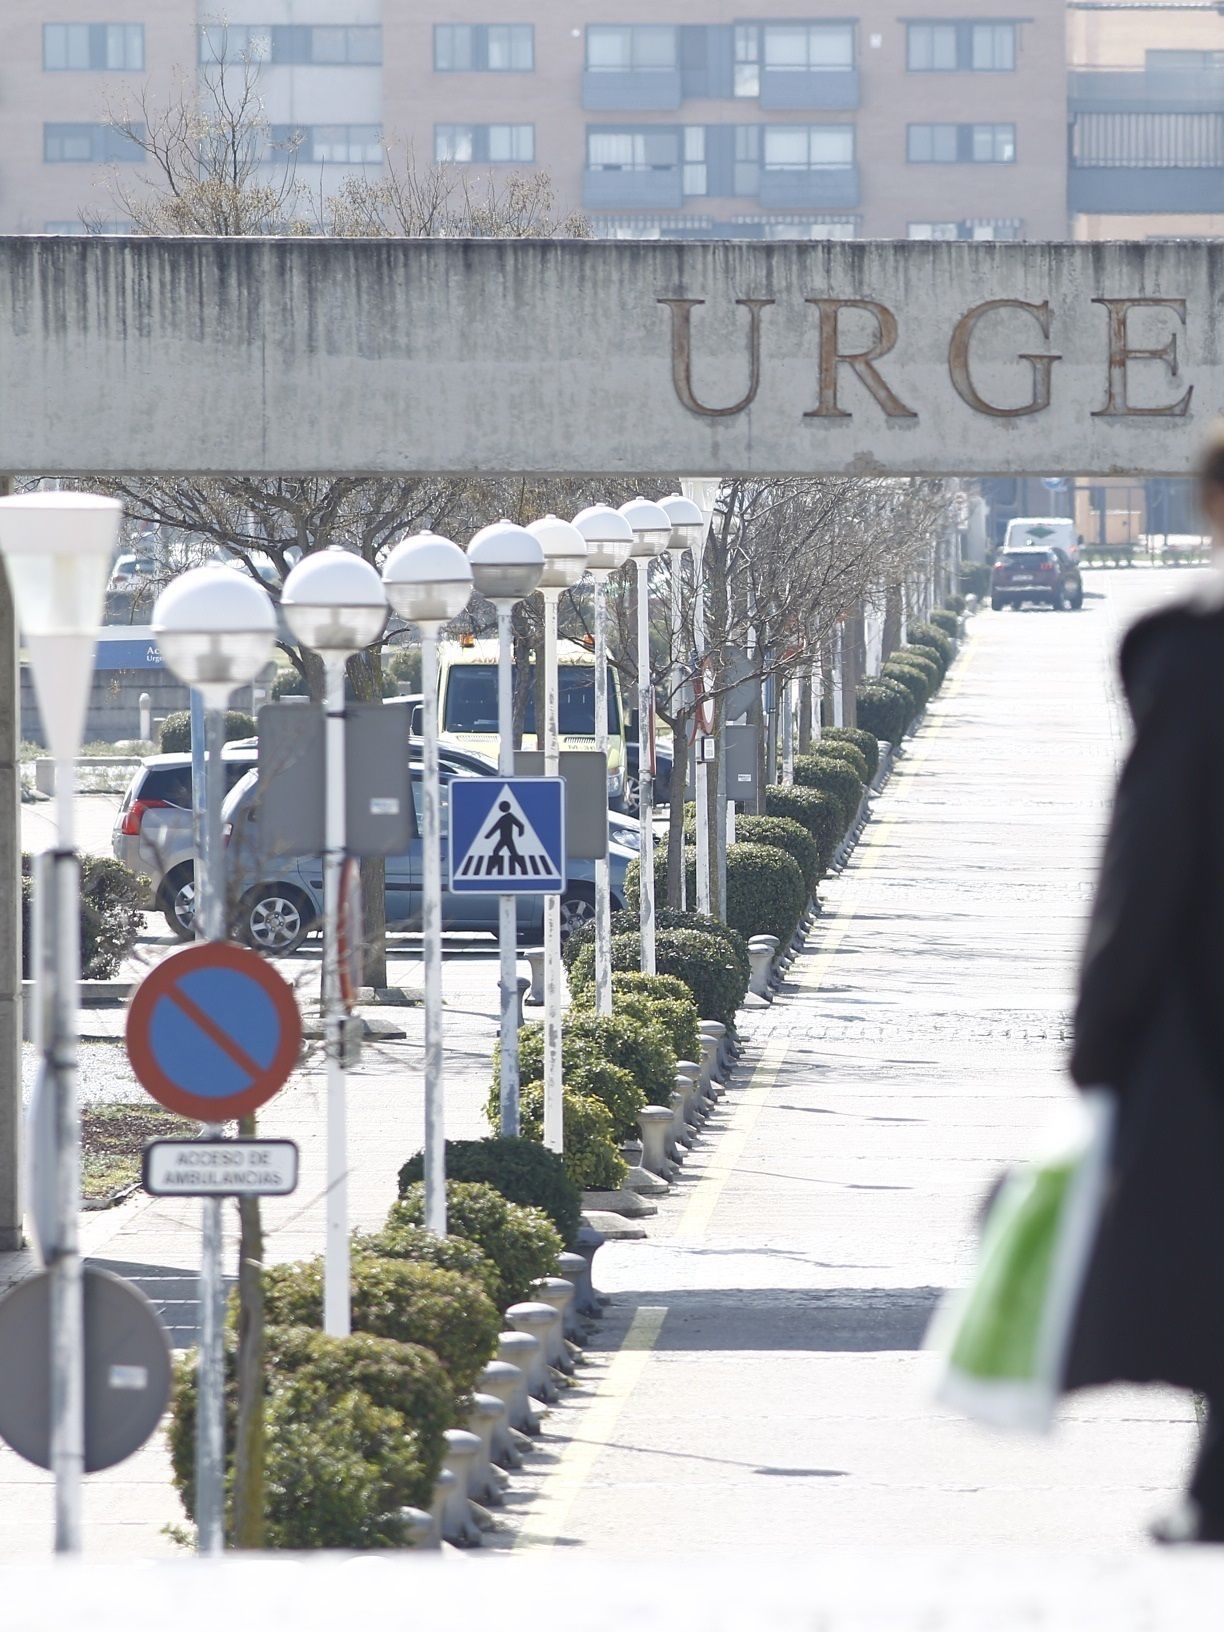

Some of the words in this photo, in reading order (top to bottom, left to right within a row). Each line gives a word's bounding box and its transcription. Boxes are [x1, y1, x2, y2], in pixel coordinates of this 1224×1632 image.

[176, 1150, 244, 1166] ACCESO
[249, 1150, 272, 1165] DE
[162, 1169, 284, 1186] AMBULANCIAS
